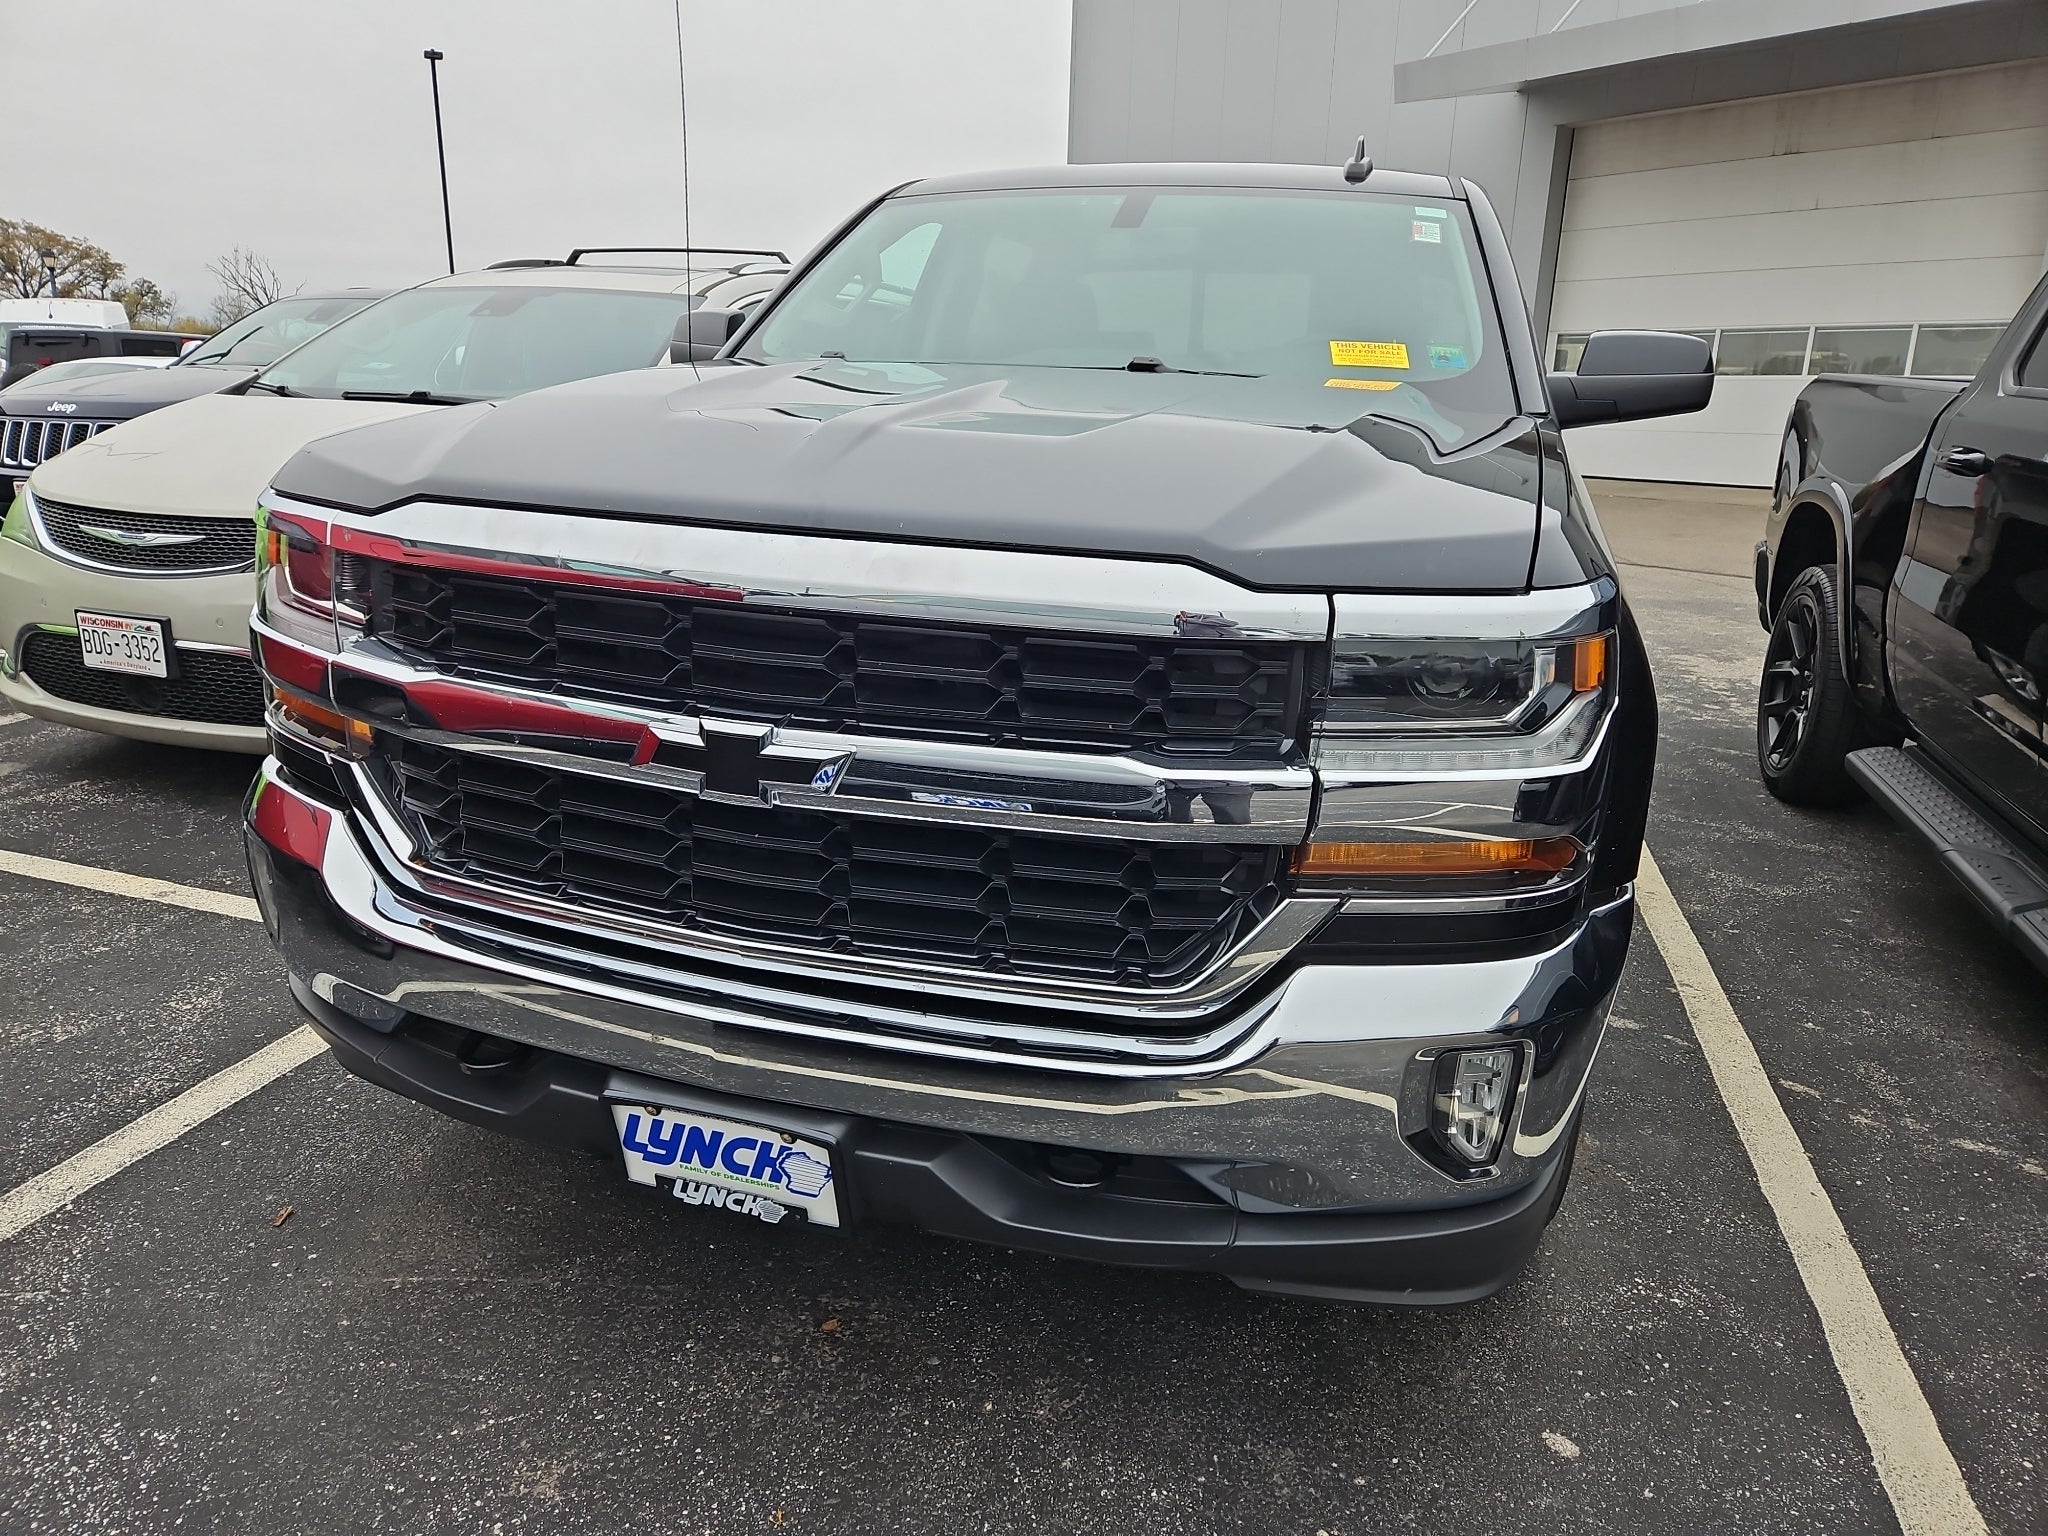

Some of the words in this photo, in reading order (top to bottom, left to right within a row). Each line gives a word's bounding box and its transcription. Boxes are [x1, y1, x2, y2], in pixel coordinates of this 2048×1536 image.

[1360, 343, 1404, 351] VEHICLE
[47, 401, 77, 414] Jeep
[80, 616, 124, 629] WISCONSIN
[82, 629, 161, 663] BDG-3352
[103, 659, 126, 668] America's
[126, 662, 148, 671] Dairyland
[622, 1113, 794, 1184] LYNCH
[678, 1164, 709, 1175] FAMILY
[723, 1173, 781, 1190] DEALERSHIPS
[672, 1178, 764, 1216] LYNCH
